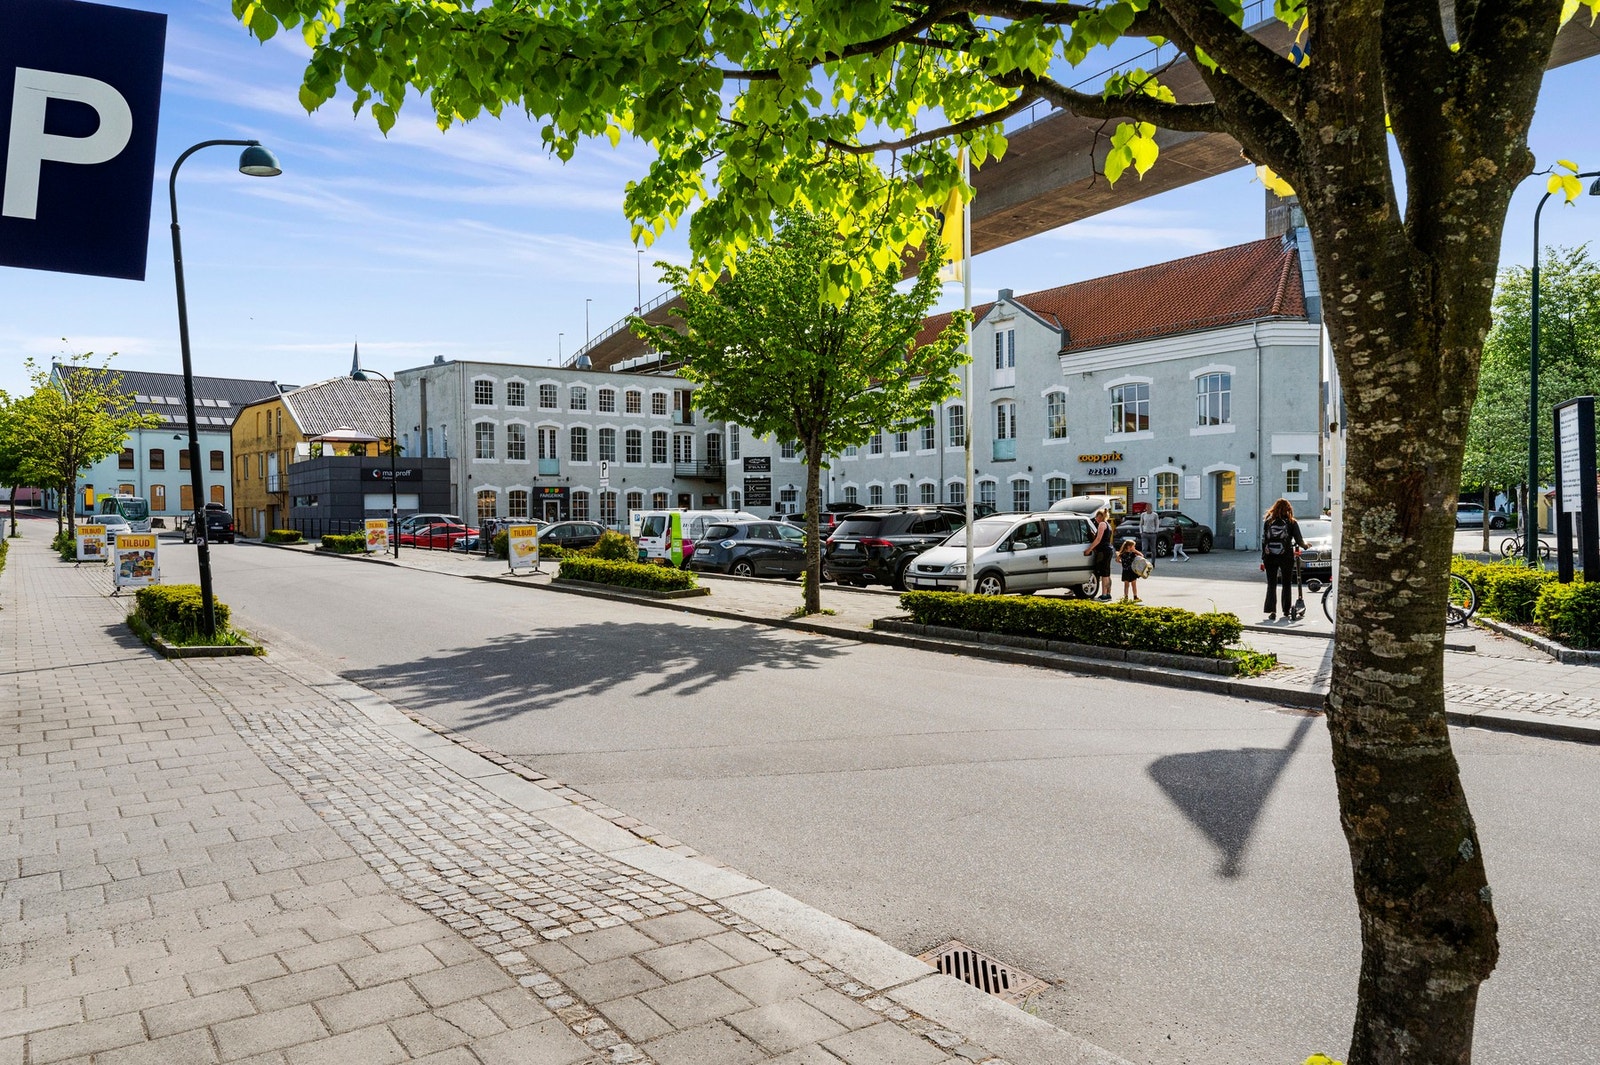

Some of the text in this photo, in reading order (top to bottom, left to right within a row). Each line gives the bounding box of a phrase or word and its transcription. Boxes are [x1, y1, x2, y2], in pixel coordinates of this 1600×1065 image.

[2, 66, 133, 220] P
[1101, 452, 1122, 462] prix
[382, 469, 412, 477] maproff
[602, 462, 607, 477] P
[1139, 477, 1146, 488] P
[513, 529, 533, 537] TILBUD
[121, 539, 150, 547] TILBUD
